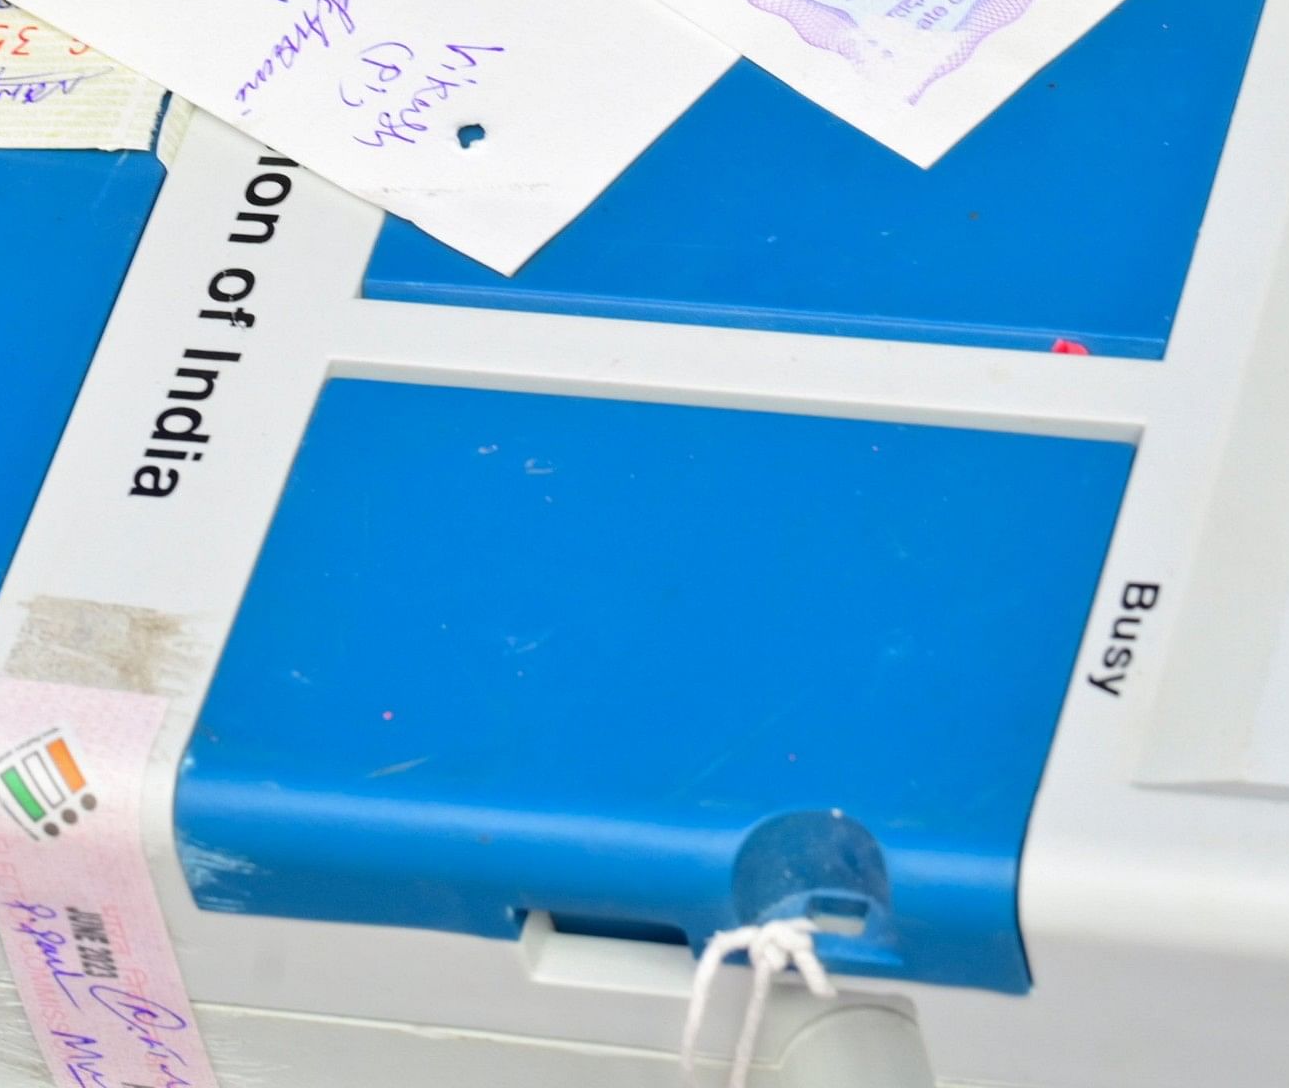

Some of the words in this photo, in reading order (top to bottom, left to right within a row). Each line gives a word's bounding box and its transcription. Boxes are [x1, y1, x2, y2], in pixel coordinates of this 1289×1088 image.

[915, 4, 950, 31] ate
[227, 148, 301, 245] ion
[197, 267, 257, 330] of
[127, 348, 243, 499] India
[1087, 581, 1161, 697] Busy
[65, 906, 111, 945] JUNE
